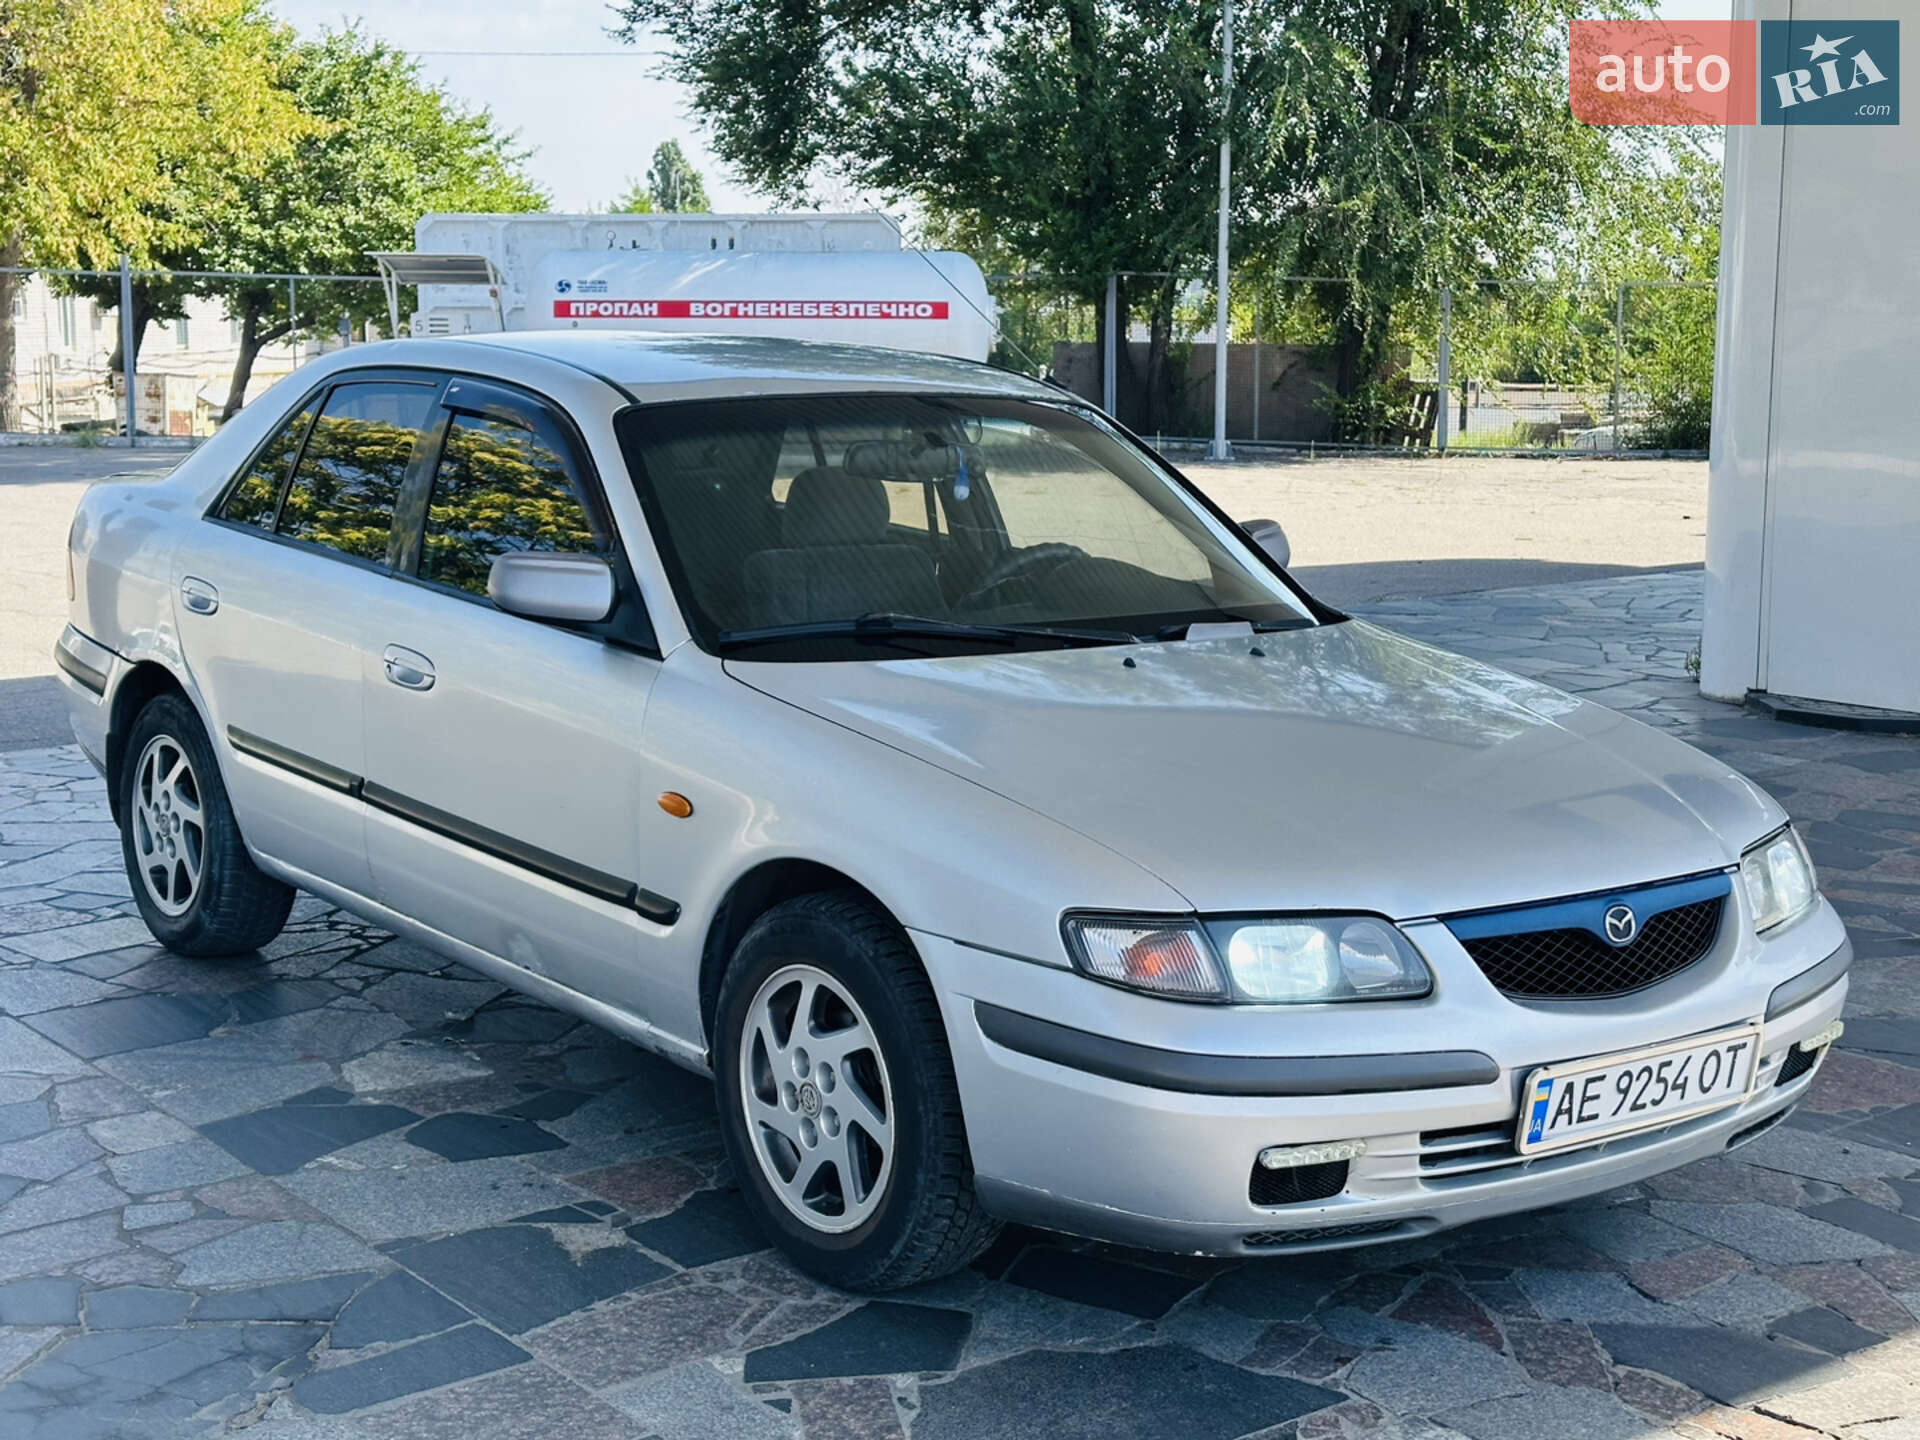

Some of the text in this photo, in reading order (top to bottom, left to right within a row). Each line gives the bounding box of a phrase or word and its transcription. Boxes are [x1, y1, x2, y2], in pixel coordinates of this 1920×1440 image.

[569, 302, 933, 318] ПРОПАН ВОГНЕНЕБЕЗПЕЧНО
[1550, 1042, 1748, 1130] AE 9254 OT
